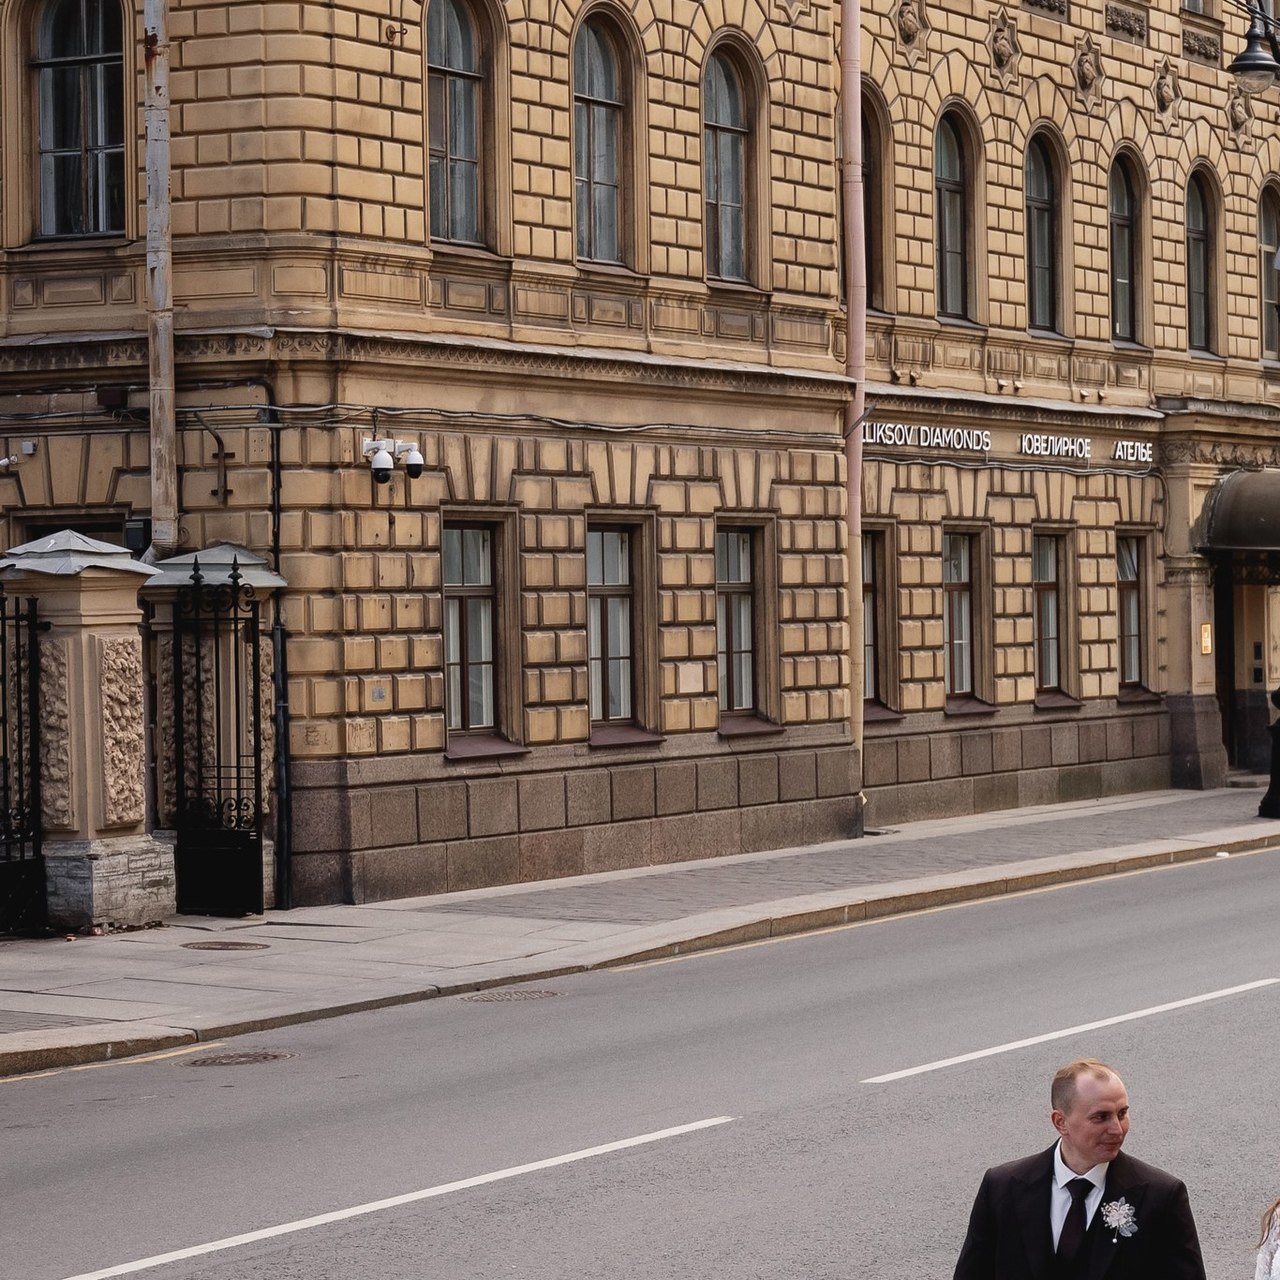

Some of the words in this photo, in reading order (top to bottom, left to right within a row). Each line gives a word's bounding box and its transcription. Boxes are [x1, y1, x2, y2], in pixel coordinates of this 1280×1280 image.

[919, 425, 992, 451] DIAMONDS
[1021, 433, 1091, 458] ЮВЕЛИРНОЕ
[1115, 440, 1153, 462] АТЕЛЬЕ
